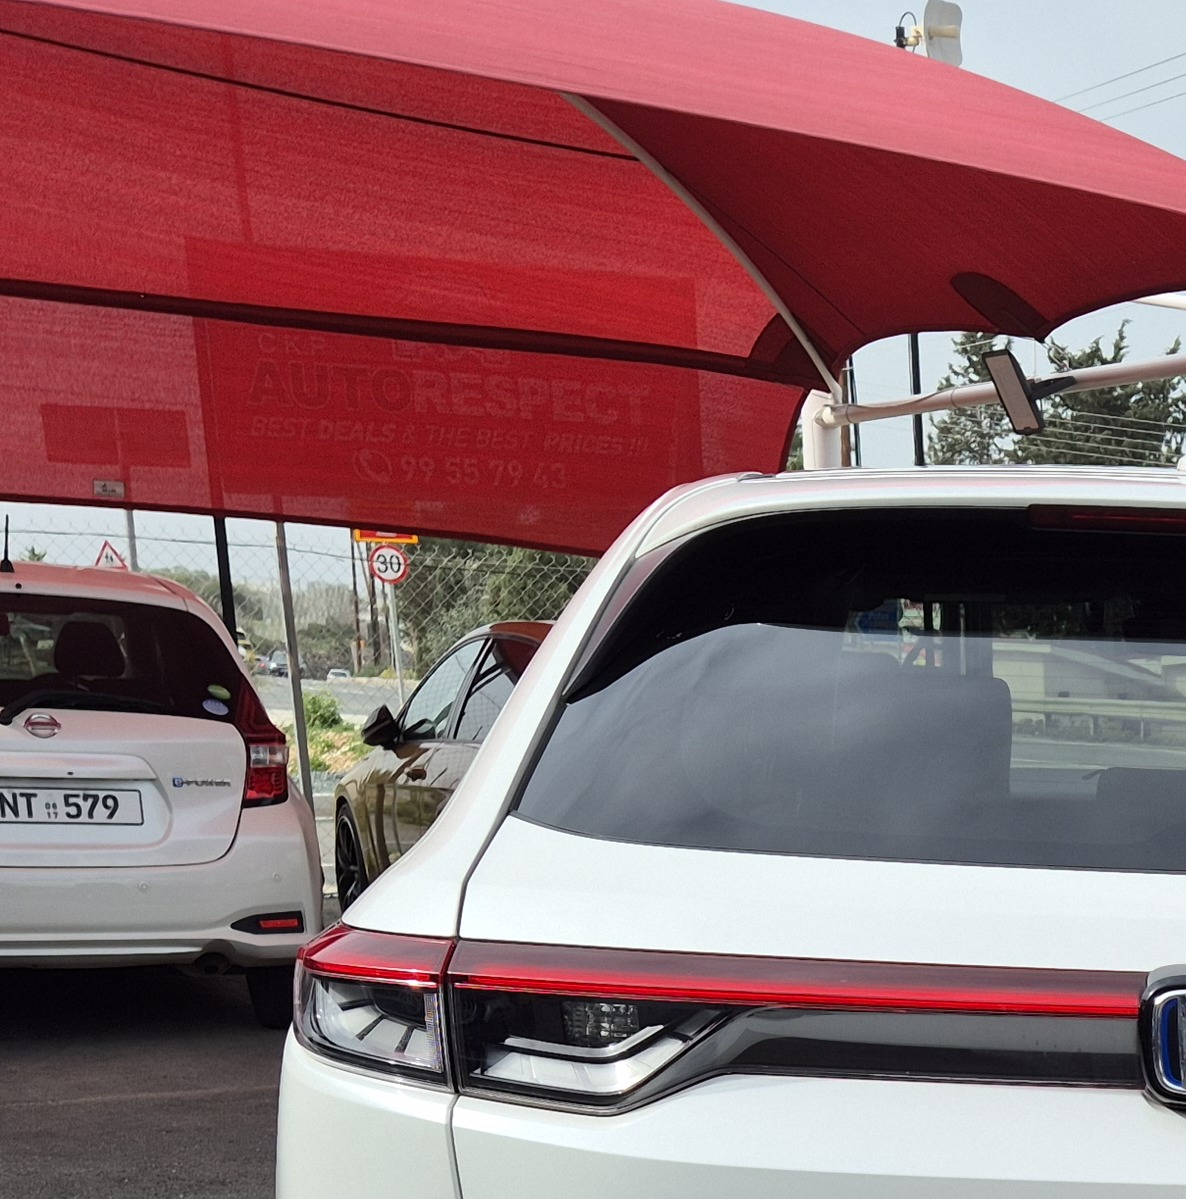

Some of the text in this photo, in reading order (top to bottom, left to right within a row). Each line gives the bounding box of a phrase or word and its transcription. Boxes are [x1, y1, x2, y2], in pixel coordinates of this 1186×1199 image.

[251, 416, 313, 438] BEST
[317, 420, 396, 442] DEALS
[402, 424, 415, 444] &
[426, 425, 472, 448] THE
[475, 428, 534, 450] BEST
[400, 454, 567, 489] 99 55 79 43
[376, 554, 401, 573] 30
[63, 793, 119, 819] 579
